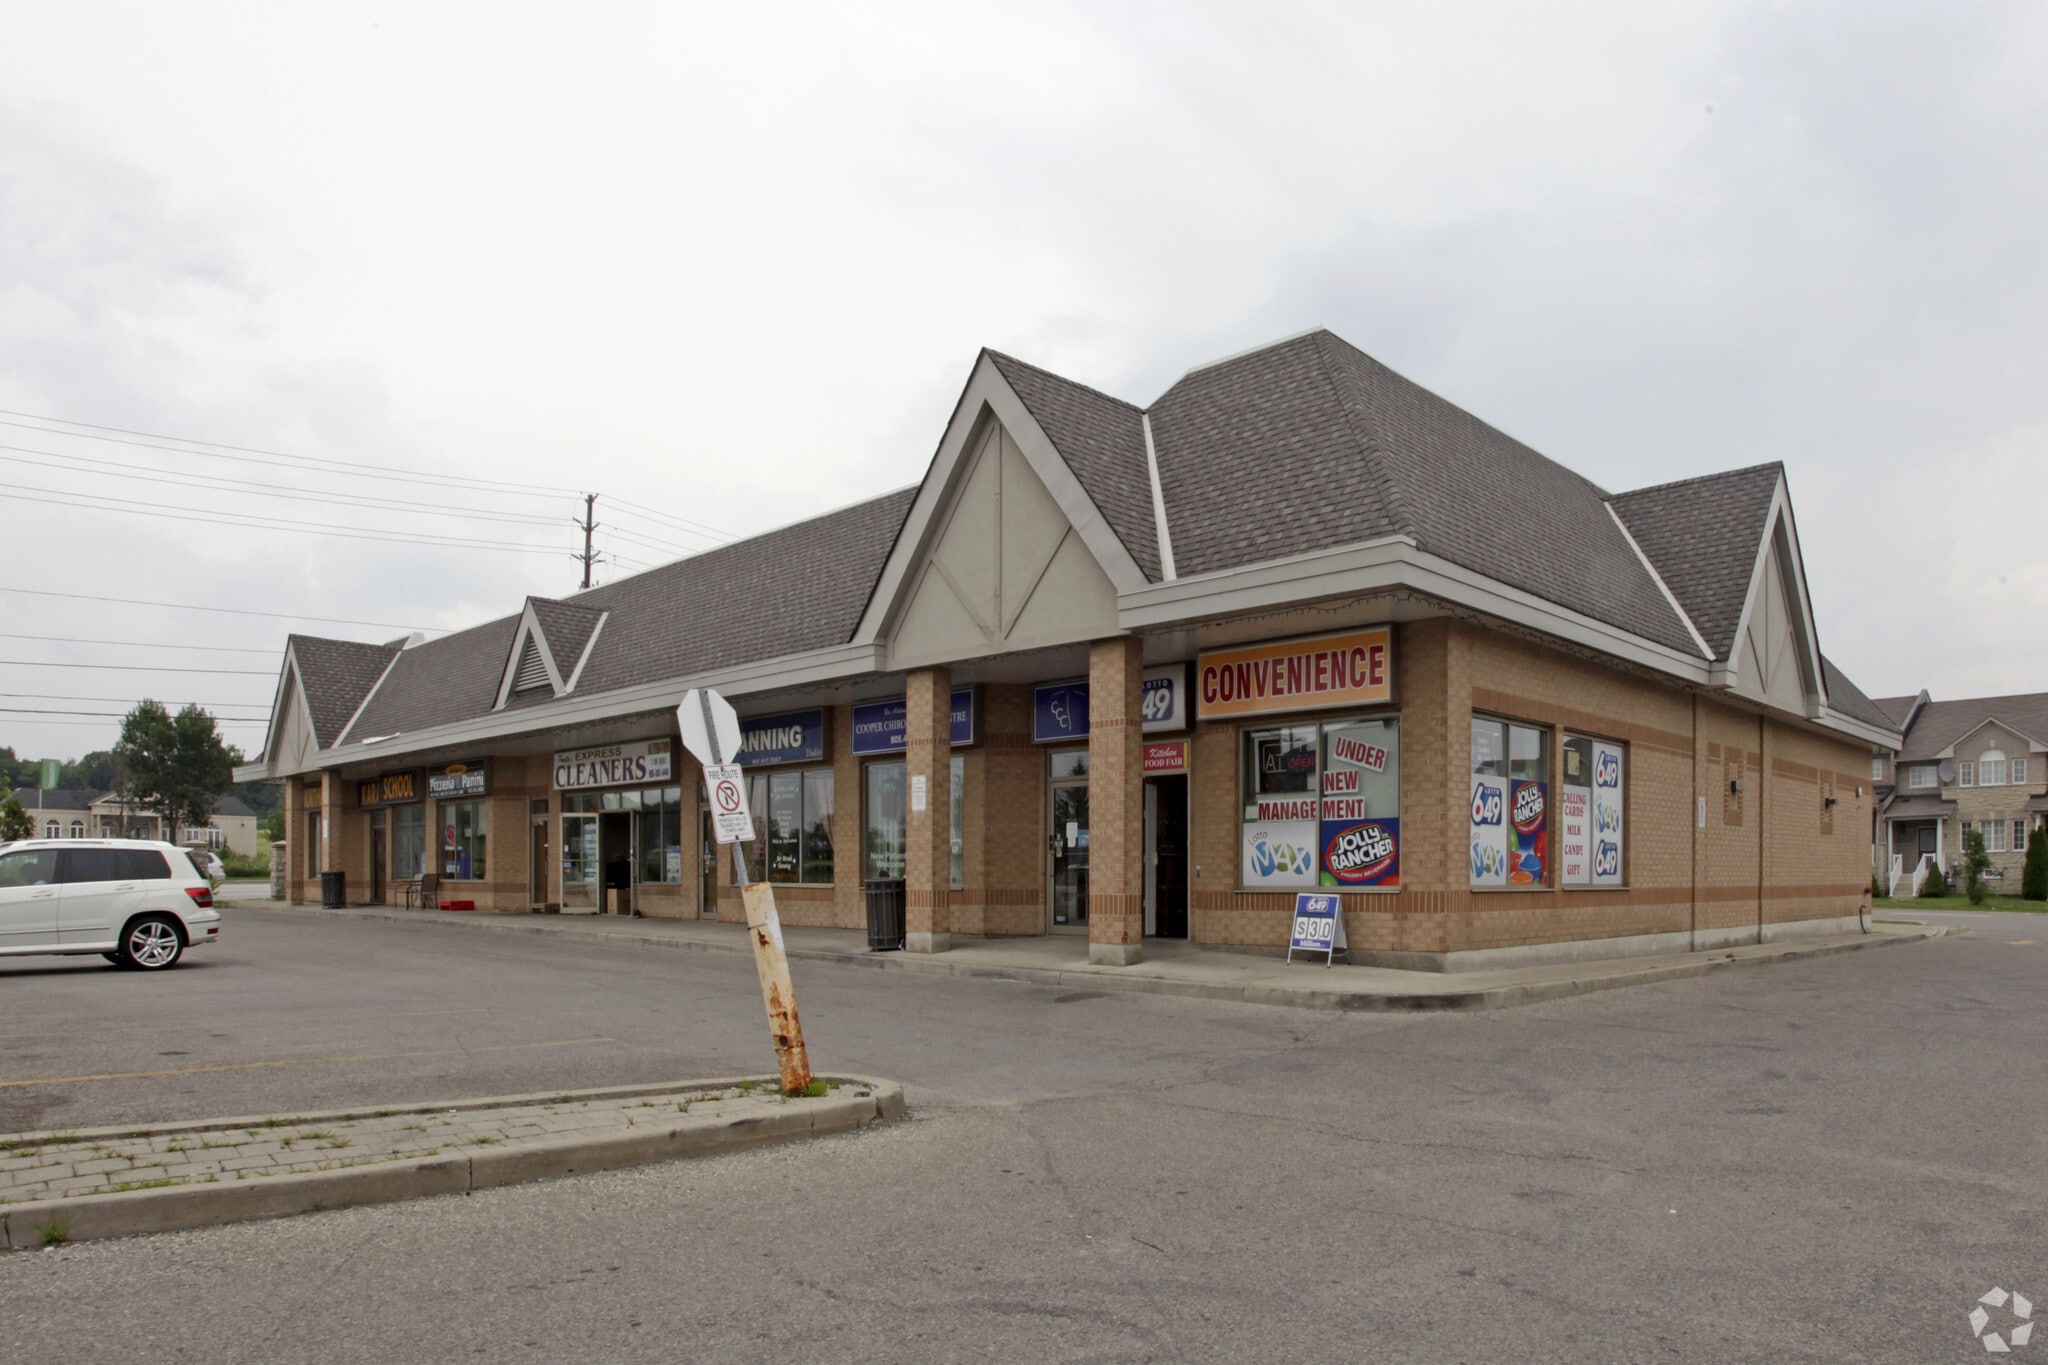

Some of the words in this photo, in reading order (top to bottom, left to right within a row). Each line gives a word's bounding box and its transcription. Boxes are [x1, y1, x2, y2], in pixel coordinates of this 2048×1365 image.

[1202, 644, 1385, 704] CONVENIENCE
[856, 723, 883, 735] COOPER
[883, 719, 907, 731] CHIRO
[737, 725, 802, 753] ANNING
[575, 746, 622, 762] EXPRESS
[1144, 758, 1165, 769] FOOD
[1166, 757, 1183, 767] FAIR
[1148, 746, 1177, 758] Kitchen
[1288, 757, 1315, 769] OPEN
[1335, 736, 1386, 769] UNDER
[430, 776, 455, 793] Pizzeria
[461, 770, 484, 789] Panini
[555, 755, 647, 788] CLEANERS
[1324, 770, 1359, 792] NEW
[384, 774, 413, 800] SCHOOL
[1517, 785, 1538, 808] JOLLY
[1258, 800, 1317, 821] MANAGE
[1322, 798, 1364, 819] MENT
[1562, 792, 1587, 806] CALLING
[1514, 798, 1544, 823] RANCHER
[1564, 804, 1584, 818] CARDS
[1248, 831, 1268, 846] Lotto
[1567, 823, 1582, 836] MILK
[1338, 827, 1381, 855] JOLLY
[1564, 844, 1584, 857] CANDY
[1250, 840, 1312, 878] MAX
[1331, 838, 1394, 871] RANCHER
[1567, 863, 1581, 876] GIFT
